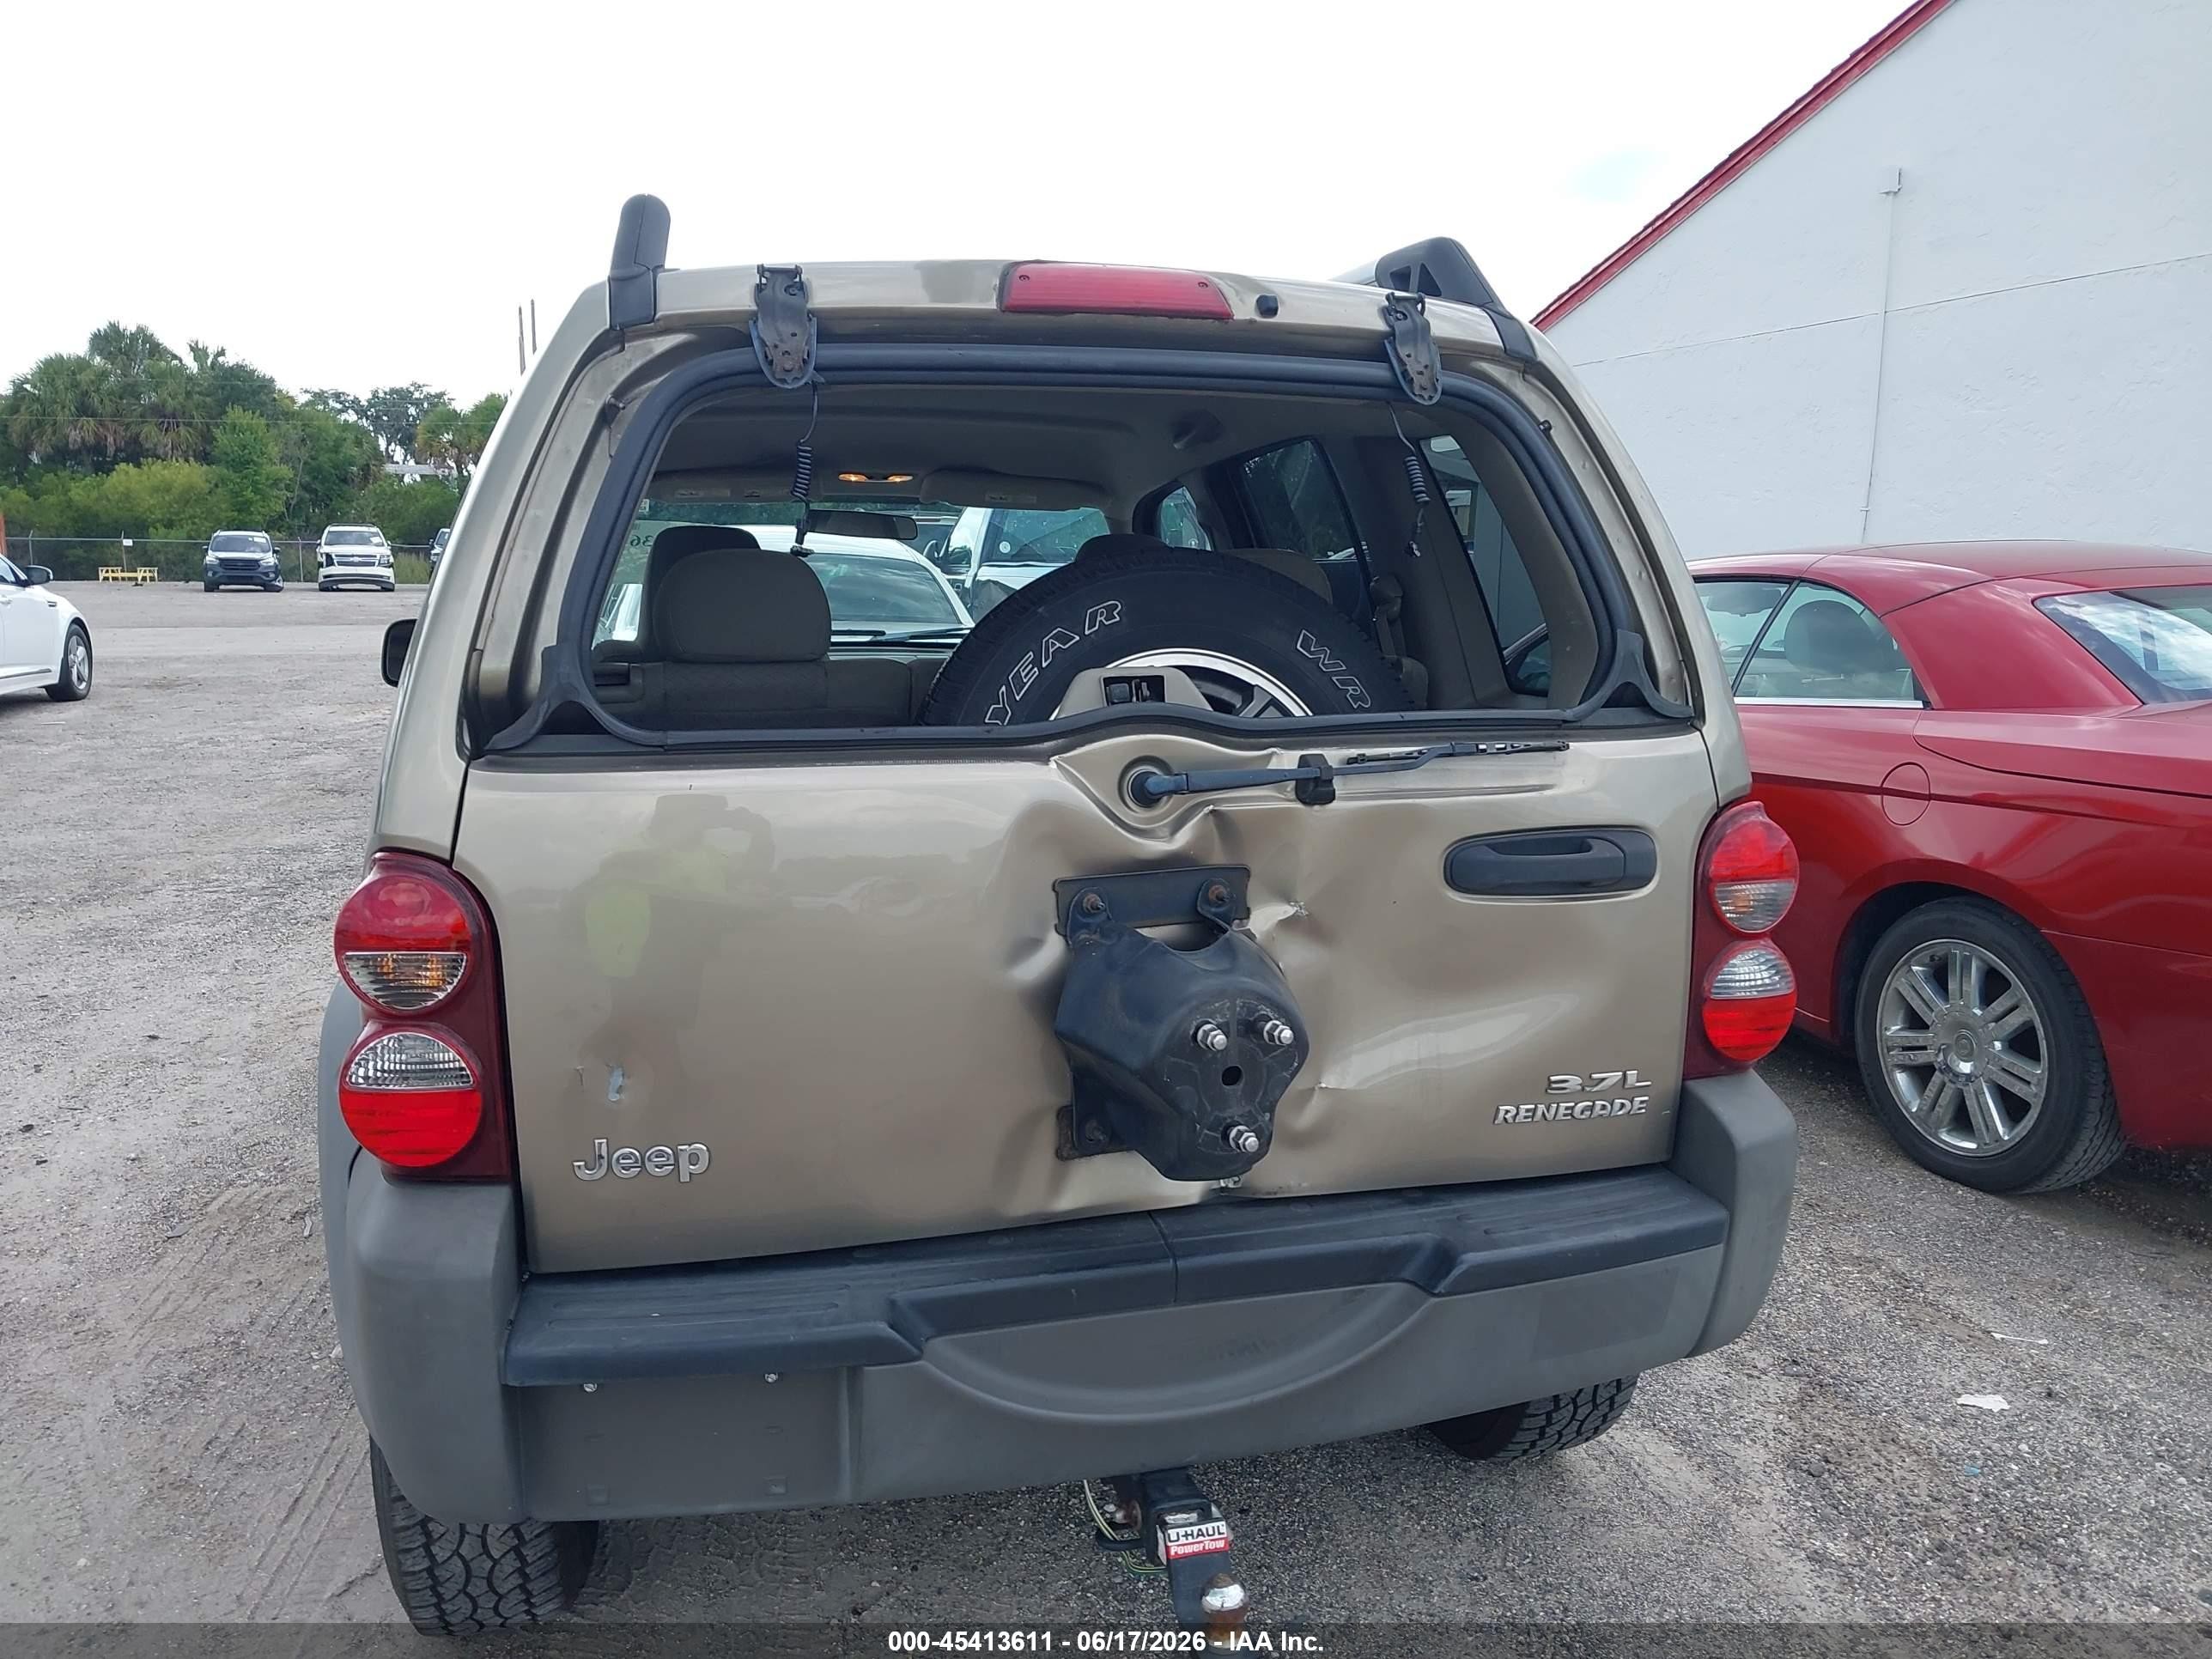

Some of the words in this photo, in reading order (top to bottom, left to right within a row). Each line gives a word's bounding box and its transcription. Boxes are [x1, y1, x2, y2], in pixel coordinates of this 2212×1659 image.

[1546, 1070, 1652, 1094] 3.7L
[1492, 1096, 1650, 1125] RENEGADE
[572, 1138, 710, 1183] Jeep
[1170, 1539, 1225, 1556] PowerTow
